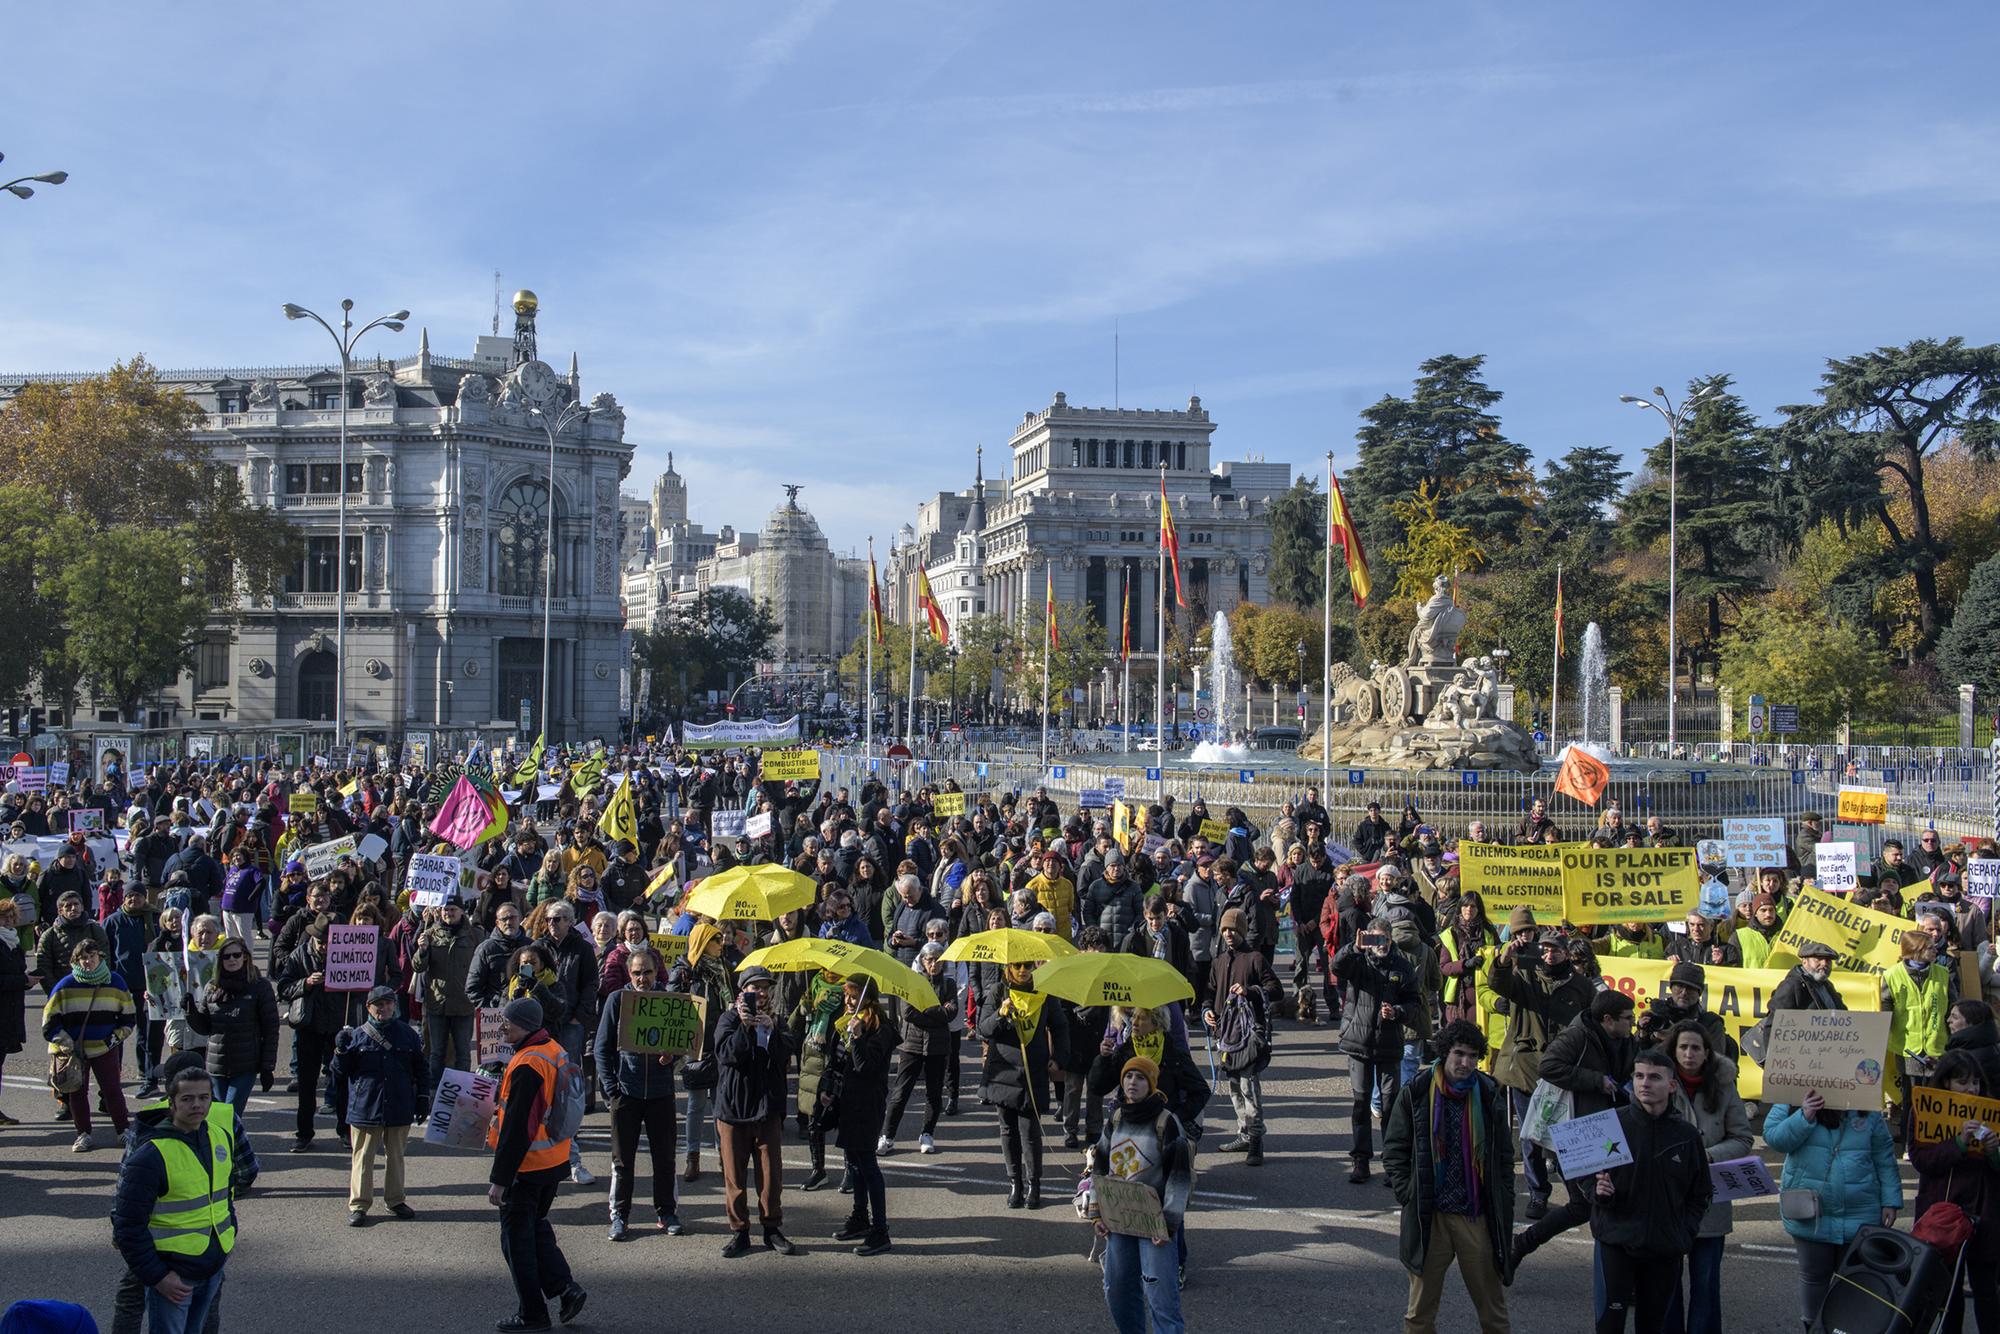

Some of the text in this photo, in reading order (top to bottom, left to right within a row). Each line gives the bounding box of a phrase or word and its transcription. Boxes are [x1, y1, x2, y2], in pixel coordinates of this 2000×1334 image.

[99, 740, 128, 748] LOEWE
[764, 757, 818, 767] COMBUSTIBLES
[781, 751, 803, 760] STOP
[429, 765, 466, 806] BURNING
[469, 766, 496, 783] DOWN
[1842, 801, 1850, 812] NO
[1851, 803, 1860, 815] hay
[1468, 846, 1517, 858] TENEMOS
[1521, 849, 1550, 859] POCA
[411, 858, 445, 874] REPARAR
[1564, 852, 1693, 869] OUR PLANET
[406, 876, 441, 892] EXPOLIOS
[1597, 871, 1663, 888] IS NOT
[1482, 885, 1503, 896] MAL
[735, 900, 747, 908] NO
[1582, 889, 1683, 907] FOR SALE
[734, 908, 756, 917] TALA
[1797, 895, 1871, 934] PETRÓLEO
[1878, 923, 1887, 939] Y
[332, 932, 375, 945] EL CAMBIO
[656, 938, 673, 951] hay
[675, 941, 686, 949] un
[331, 948, 374, 964] CLIMÁTICO
[826, 947, 848, 958] TALA
[972, 951, 994, 959] TALA
[329, 970, 372, 983] NOS MATA.
[1103, 981, 1119, 991] NO
[1102, 991, 1132, 1002] TALA
[663, 1018, 686, 1028] YOUR
[1811, 1015, 1852, 1027] MENOS
[1774, 1028, 1860, 1042] RESPONSABLES
[480, 1042, 515, 1055] la Tierra
[1818, 1046, 1832, 1056] que
[1840, 1045, 1865, 1058] sufren
[1772, 1057, 1796, 1070] MÁS
[1768, 1072, 1856, 1091] CONSECUENCIAS
[431, 1081, 461, 1134] ¡NO NOS
[1915, 1094, 1942, 1115] ¡No
[1738, 1161, 1758, 1175] We
